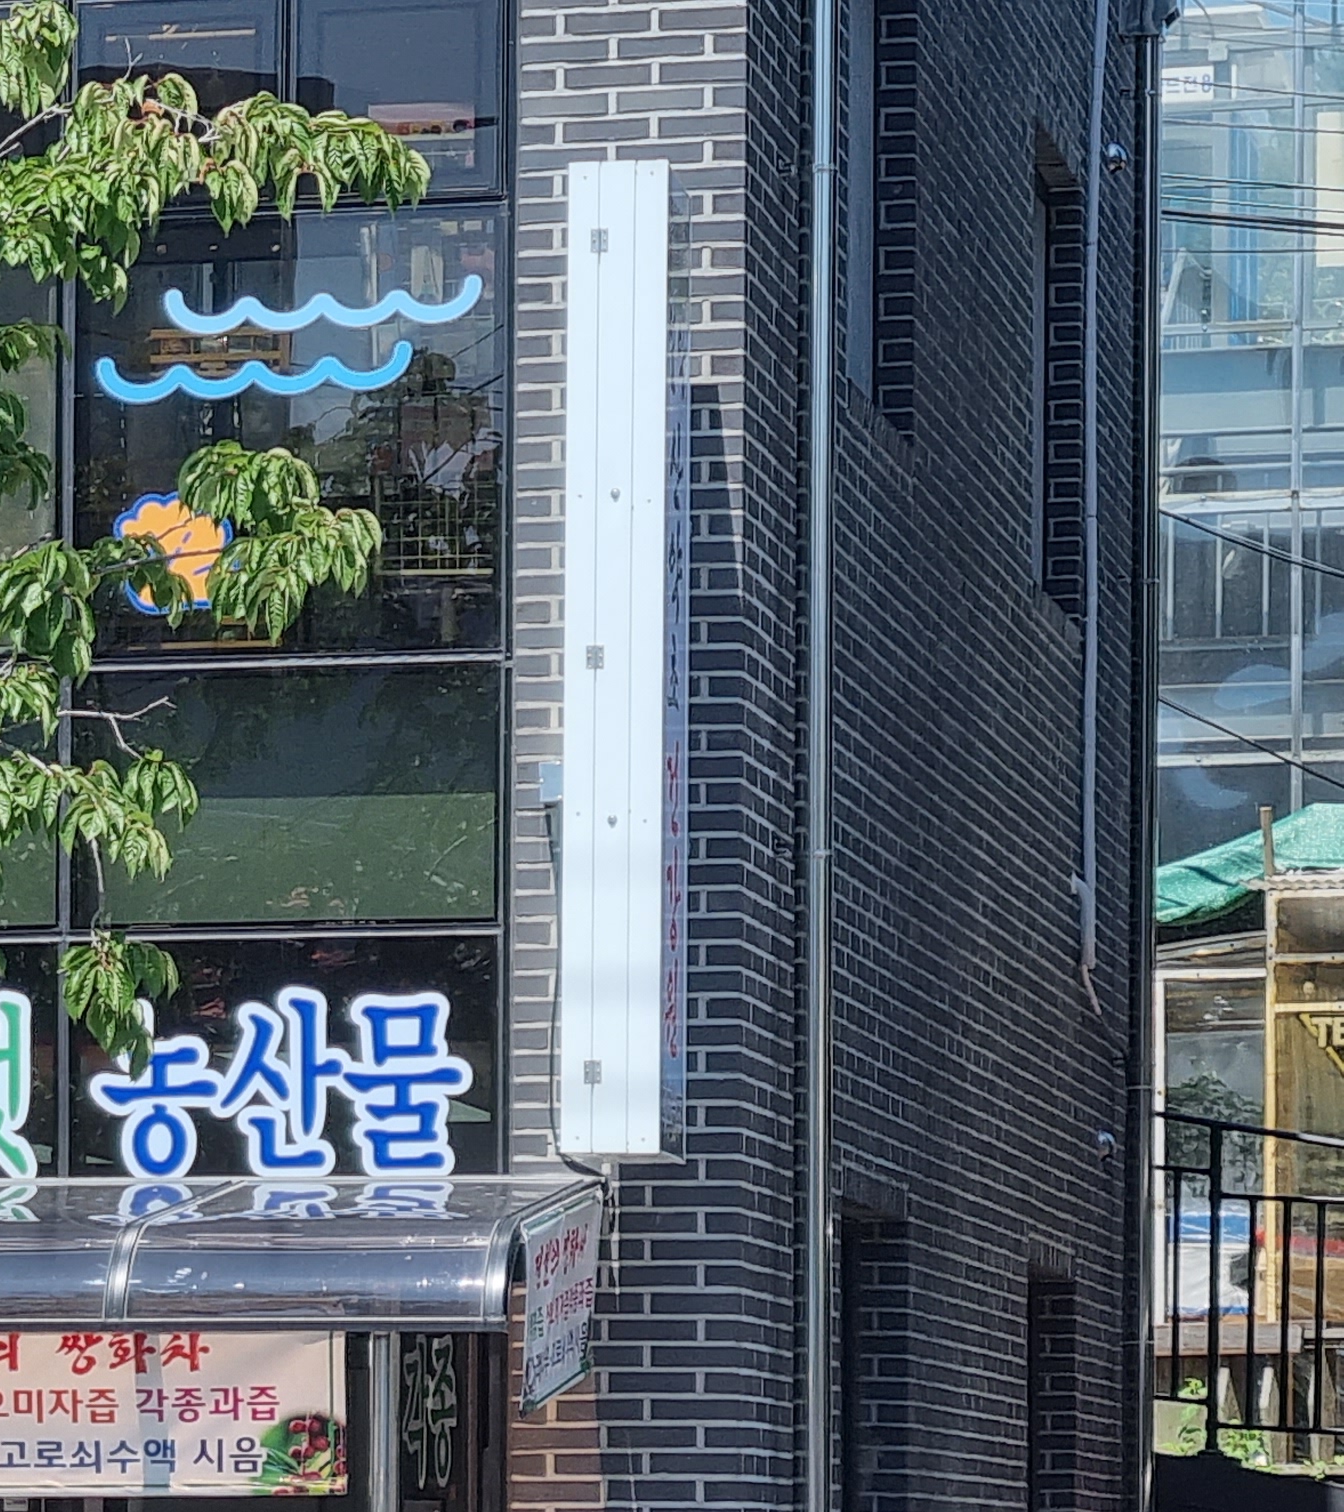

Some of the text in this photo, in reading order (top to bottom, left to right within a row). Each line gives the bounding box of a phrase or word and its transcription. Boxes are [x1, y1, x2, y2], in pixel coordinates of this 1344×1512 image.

[89, 986, 474, 1179] 농산물
[54, 1333, 211, 1373] 쌍화차
[135, 1385, 281, 1422] 각종과즙
[402, 1333, 459, 1491] 각종
[191, 1435, 265, 1473] 시음
